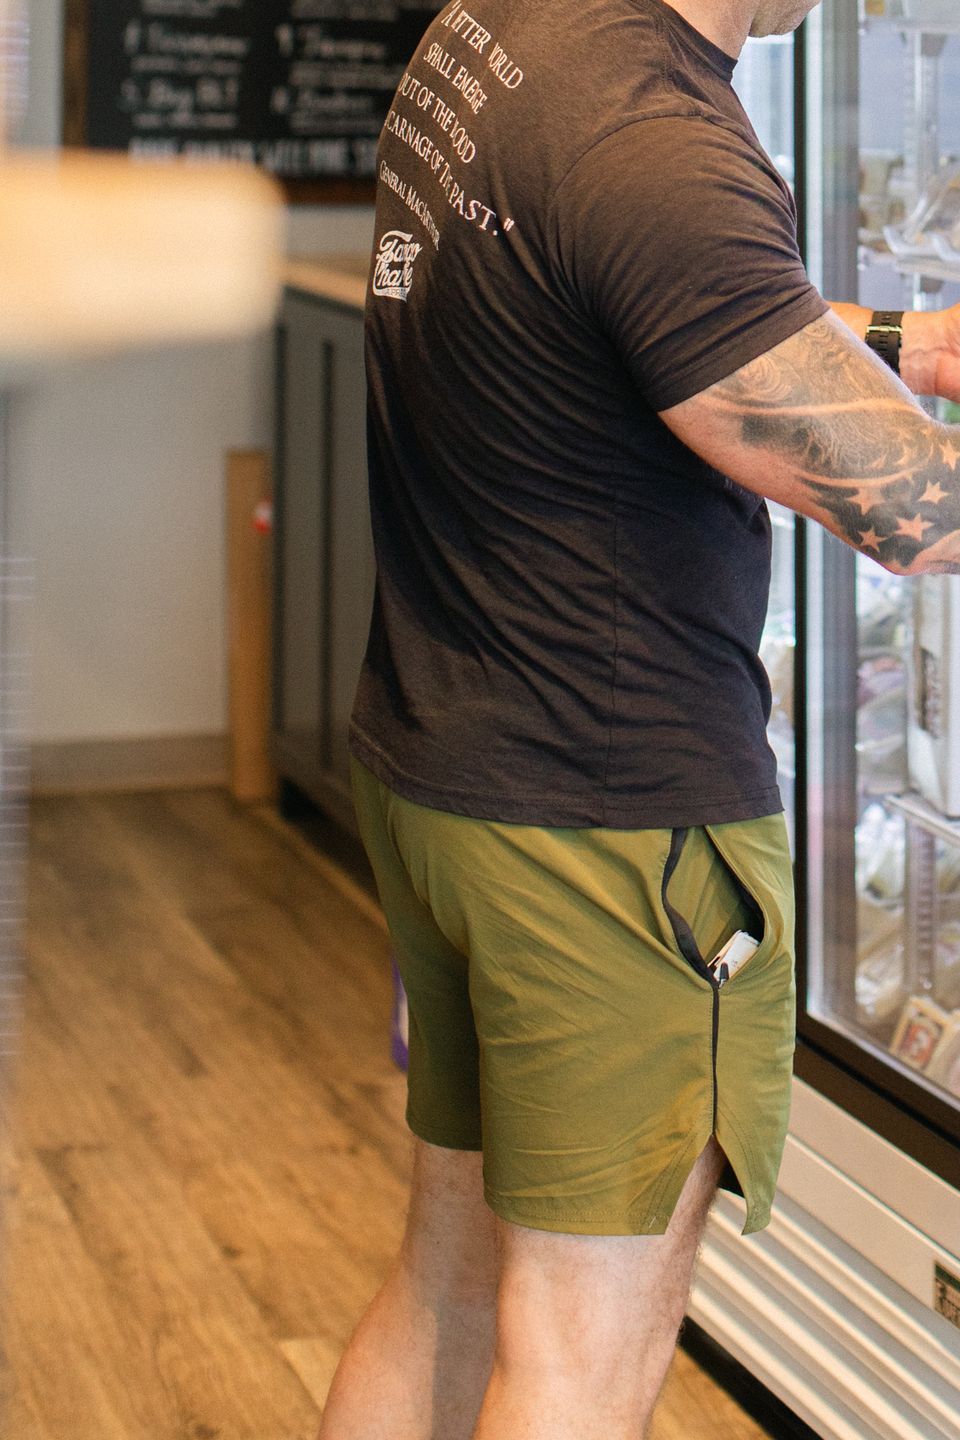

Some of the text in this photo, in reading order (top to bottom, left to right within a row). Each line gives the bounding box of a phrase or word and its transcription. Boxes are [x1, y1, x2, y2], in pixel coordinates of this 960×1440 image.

[423, 42, 456, 79] SHALL
[416, 86, 435, 111] OF
[432, 97, 456, 131] THE
[386, 110, 434, 162] CARNAGE
[430, 149, 445, 174] OF
